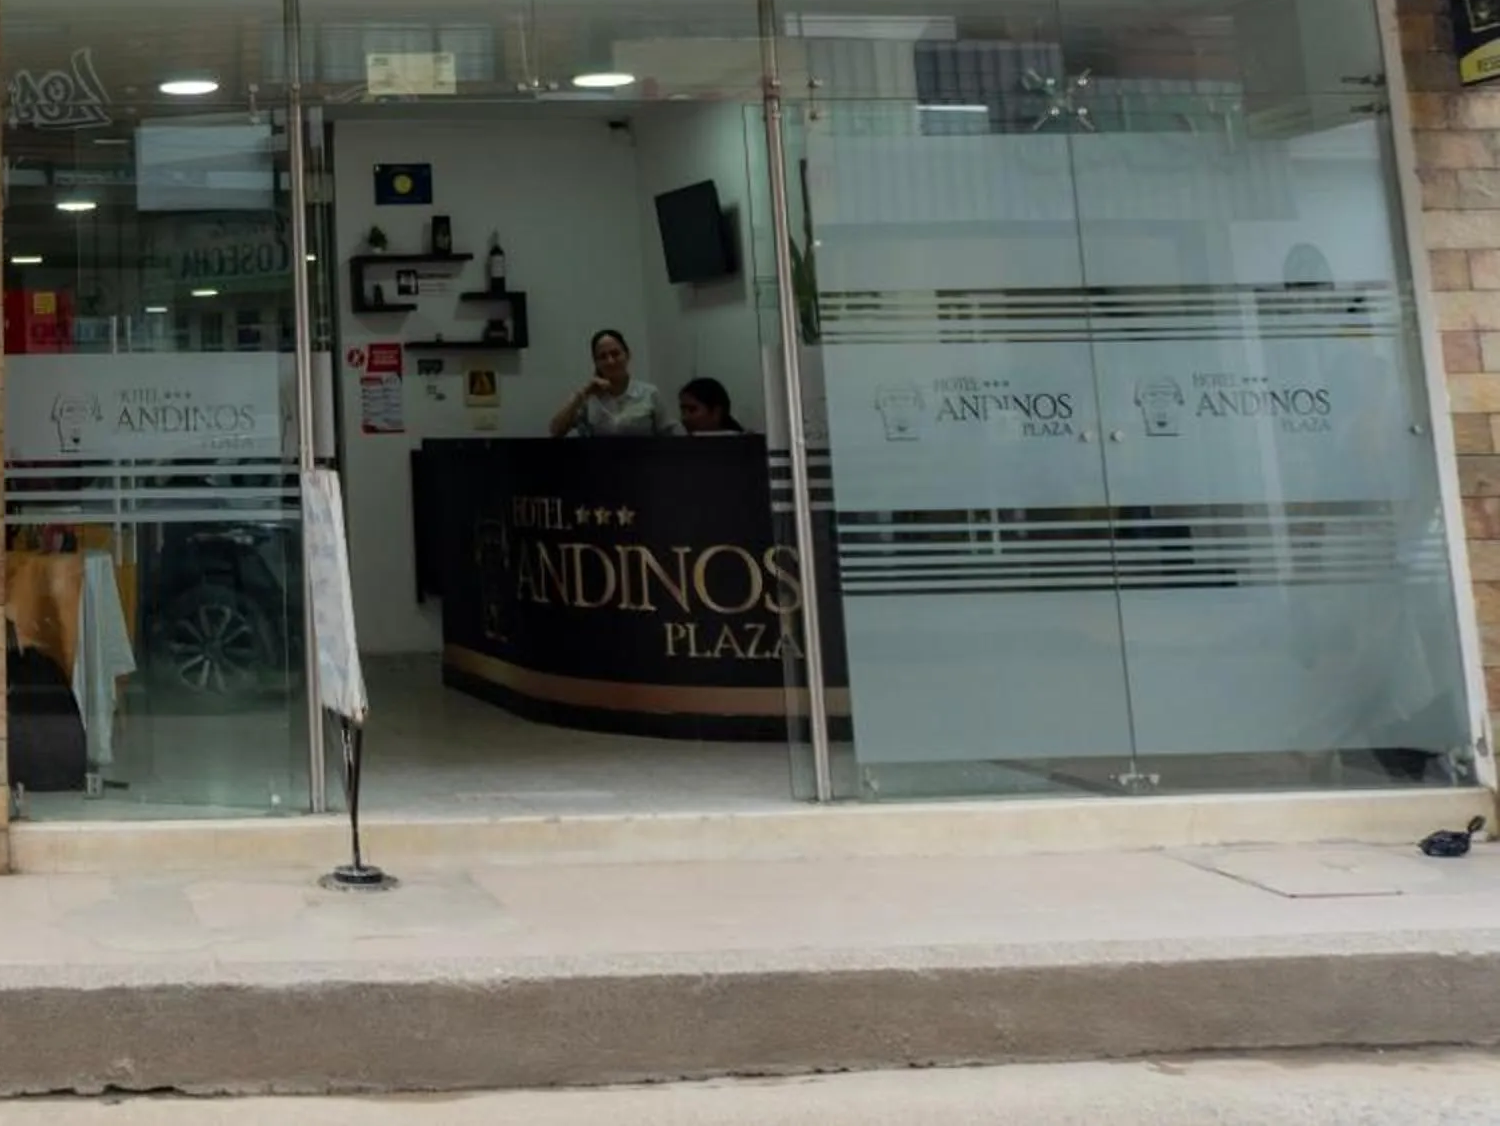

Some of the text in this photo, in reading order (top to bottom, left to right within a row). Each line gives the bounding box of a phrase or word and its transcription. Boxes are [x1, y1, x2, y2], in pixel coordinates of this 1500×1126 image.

[117, 403, 257, 433] ANDINOS
[1195, 388, 1332, 418] ANDINOS
[516, 540, 803, 615] ANDINOS
[664, 622, 805, 659] PLAZA
